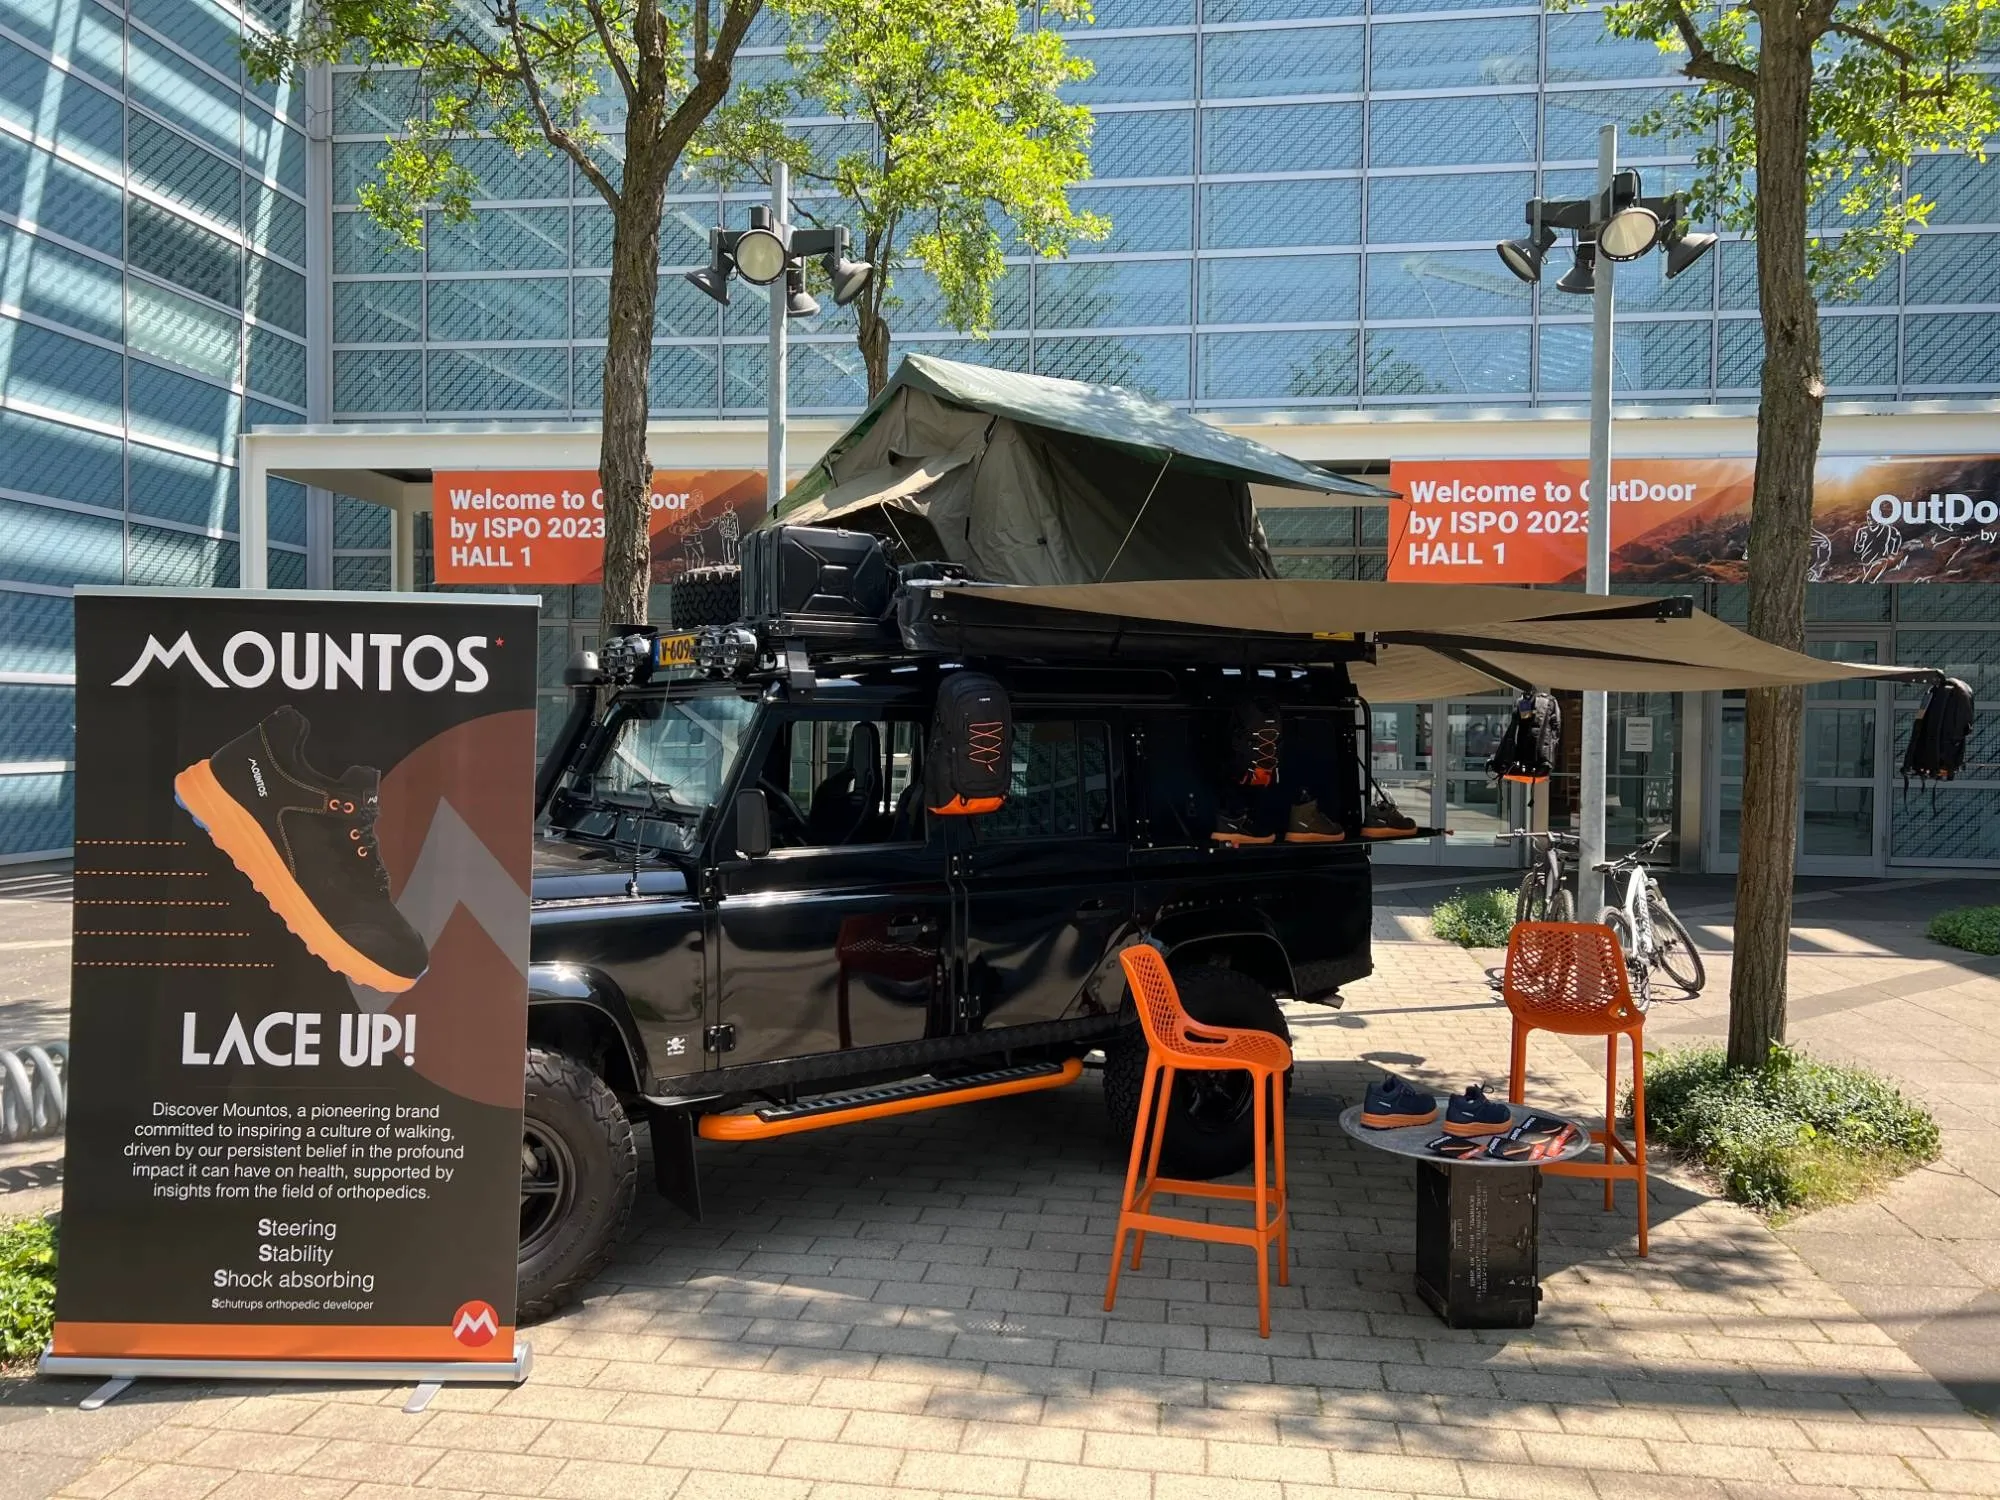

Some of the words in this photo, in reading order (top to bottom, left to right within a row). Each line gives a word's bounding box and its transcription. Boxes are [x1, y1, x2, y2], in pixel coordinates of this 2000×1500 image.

[450, 488, 555, 510] Welcome
[561, 490, 585, 510] to
[1410, 480, 1536, 503] Welcome
[1544, 482, 1571, 502] to
[1870, 493, 2000, 525] OutDo
[450, 517, 477, 544] by
[484, 517, 541, 538] ISPO
[547, 517, 606, 538] 2023
[1409, 510, 1442, 539] by
[1451, 511, 1519, 534] ISPO
[1981, 529, 1998, 543] by
[451, 546, 513, 567] HALL
[520, 546, 531, 566] 1
[1409, 543, 1483, 565] HALL
[1493, 542, 1505, 564] 1
[111, 631, 488, 692] MOUNTOS
[248, 756, 268, 798] MOUNTOS
[182, 1012, 321, 1066] LACE
[340, 1012, 416, 1067] UP!
[153, 1103, 218, 1116] Discover
[223, 1103, 291, 1117] Mountos,
[297, 1107, 306, 1117] a
[312, 1103, 390, 1124] pioneering
[396, 1104, 439, 1118] brand
[135, 1123, 213, 1136] committed
[218, 1124, 232, 1136] to
[238, 1124, 301, 1140] inspiring
[307, 1127, 315, 1137] a
[320, 1124, 371, 1137] culture
[376, 1124, 390, 1137] of
[395, 1125, 454, 1141] walking,
[124, 1142, 170, 1156] driven
[176, 1144, 194, 1160] by
[199, 1146, 222, 1156] our
[228, 1144, 301, 1161] persistent
[306, 1143, 347, 1157] belief
[352, 1144, 364, 1158] in
[370, 1145, 392, 1158] the
[397, 1144, 463, 1162] profound
[133, 1163, 183, 1179] impact
[189, 1164, 197, 1177] it
[202, 1167, 229, 1177] can
[235, 1163, 270, 1177] have
[276, 1168, 293, 1178] on
[299, 1164, 347, 1179] health,
[354, 1165, 430, 1181] supported
[436, 1166, 454, 1182] by
[154, 1183, 210, 1200] insights
[216, 1184, 249, 1197] from
[255, 1184, 277, 1197] the
[283, 1185, 313, 1198] field
[319, 1184, 332, 1198] of
[337, 1185, 429, 1202] orthopedics.
[258, 1219, 336, 1240] Steering
[259, 1244, 333, 1266] Stability
[214, 1270, 272, 1287] Shock
[279, 1271, 374, 1292] absorbing
[212, 1298, 263, 1311] Schutrups
[266, 1300, 320, 1310] orthopedic
[323, 1300, 373, 1311] developer
